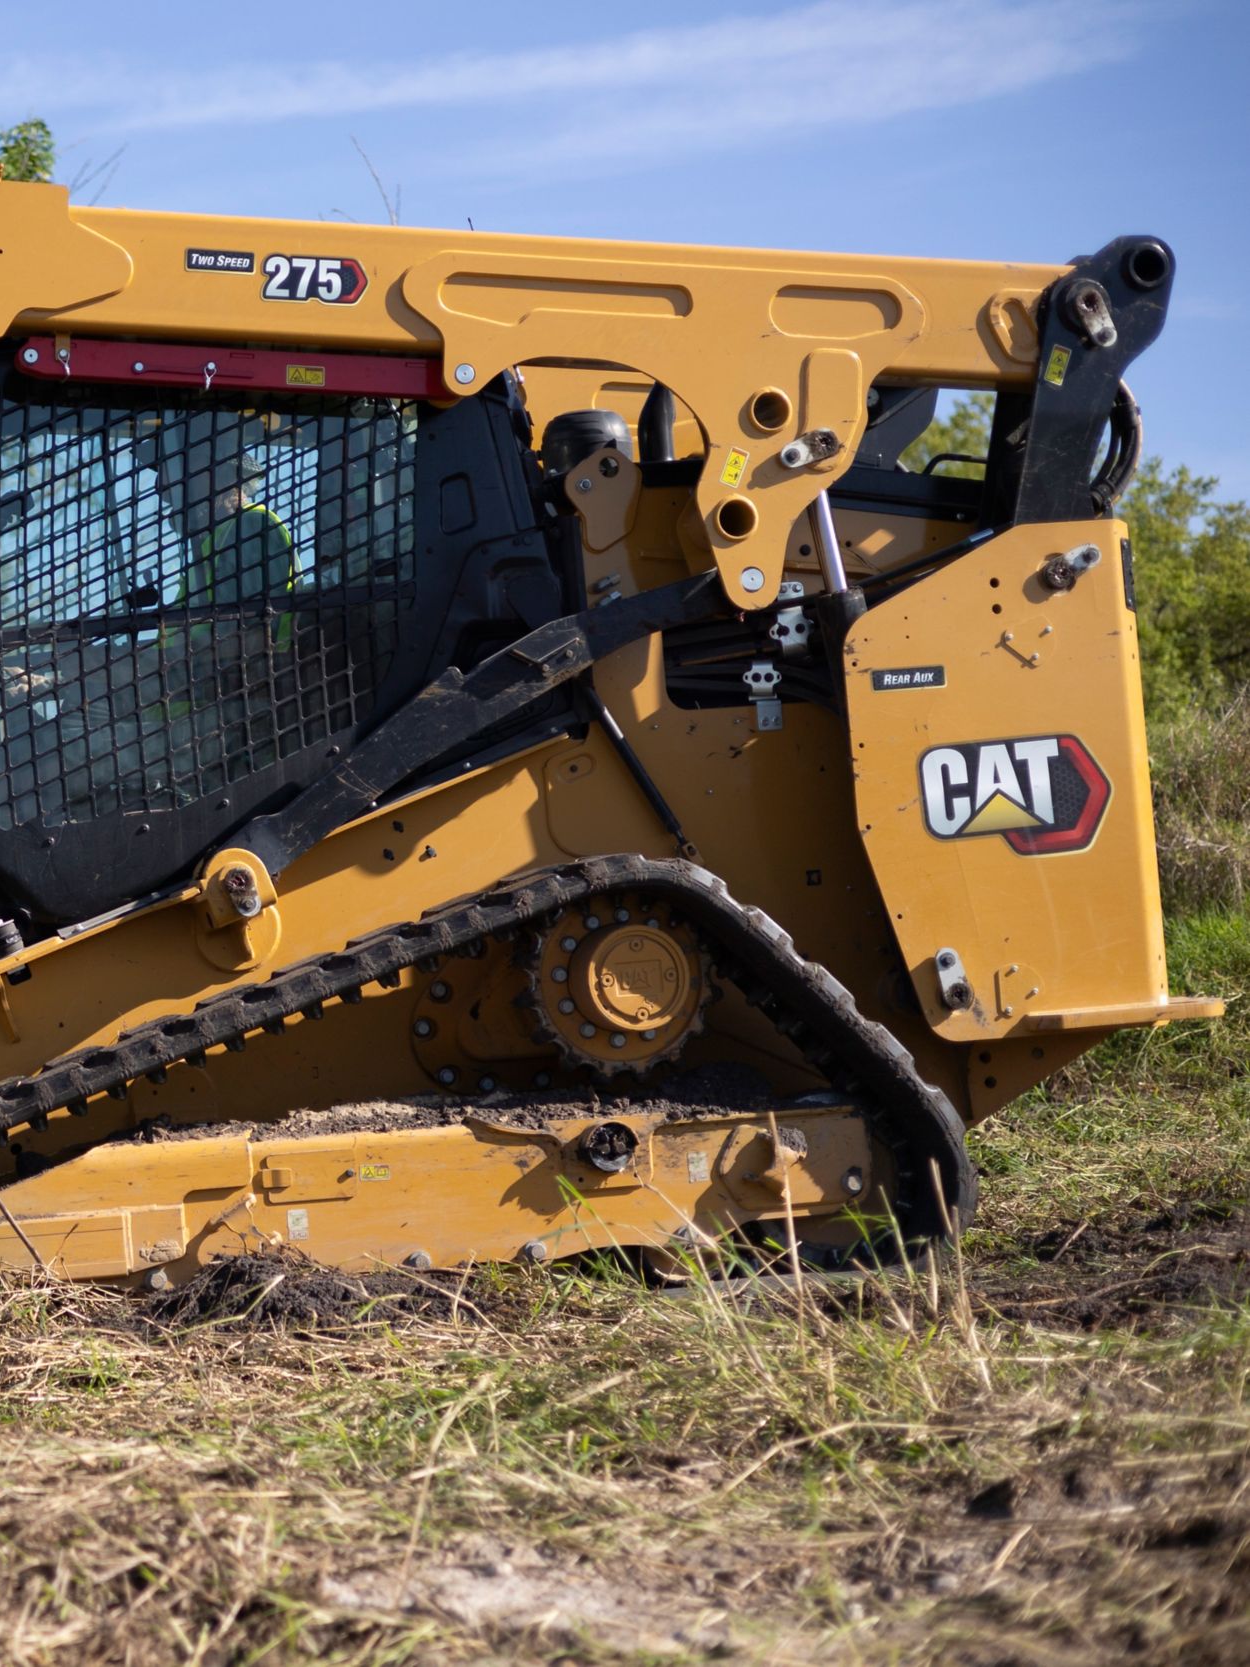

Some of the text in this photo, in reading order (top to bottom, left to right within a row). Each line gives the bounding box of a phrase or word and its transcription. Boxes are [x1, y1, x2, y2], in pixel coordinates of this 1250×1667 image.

[191, 253, 250, 268] TWO SPEED
[265, 256, 342, 301] 275
[883, 671, 934, 686] REAR AUX
[921, 738, 1059, 836] CAT
